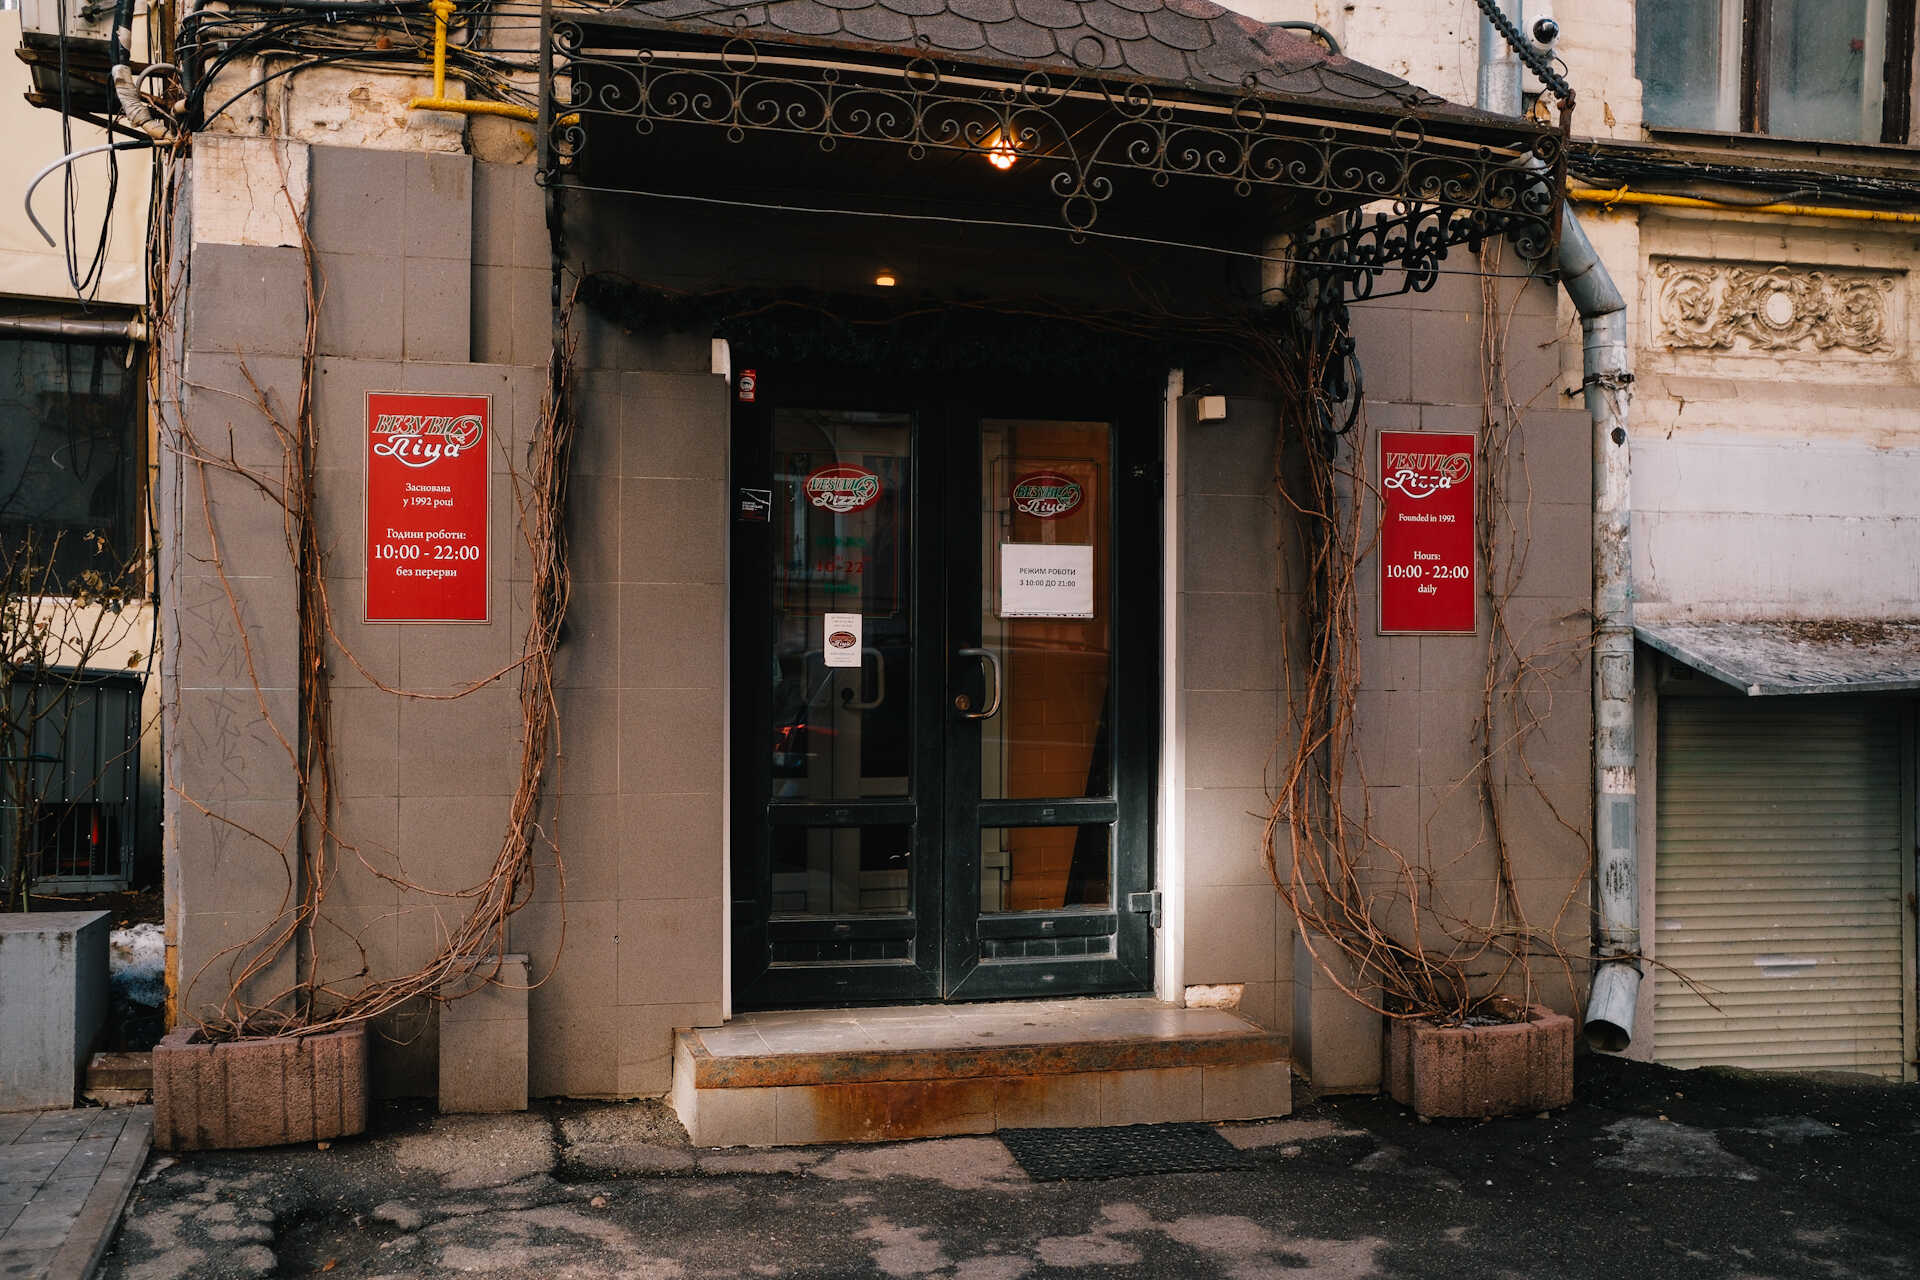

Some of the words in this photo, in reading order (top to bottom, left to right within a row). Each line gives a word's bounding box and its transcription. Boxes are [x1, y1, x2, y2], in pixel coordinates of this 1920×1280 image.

[374, 434, 461, 467] Піца
[405, 482, 451, 493] Заснована
[1384, 469, 1452, 499] Pizza
[402, 498, 409, 507] у
[411, 497, 432, 506] 1992
[433, 498, 454, 509] році
[812, 492, 866, 513] Pizza
[1018, 499, 1067, 517] Піца
[1398, 513, 1430, 523] Founded
[1430, 514, 1438, 523] in
[1439, 514, 1456, 523] 1992
[386, 528, 424, 540] Години
[425, 529, 467, 543] роботи:
[374, 544, 420, 560] 10:00
[433, 545, 480, 561] 22:00
[1413, 551, 1441, 561] Hours:
[396, 566, 413, 577] без
[414, 568, 457, 579] перерви
[1019, 567, 1047, 575] РЕЖИМ
[1047, 568, 1077, 576] РОБОТИ
[1386, 564, 1422, 579] 10:00
[1432, 565, 1469, 579] 22:00
[1025, 579, 1045, 587] 10:00
[1045, 580, 1057, 588] ДО
[1417, 584, 1438, 596] daily
